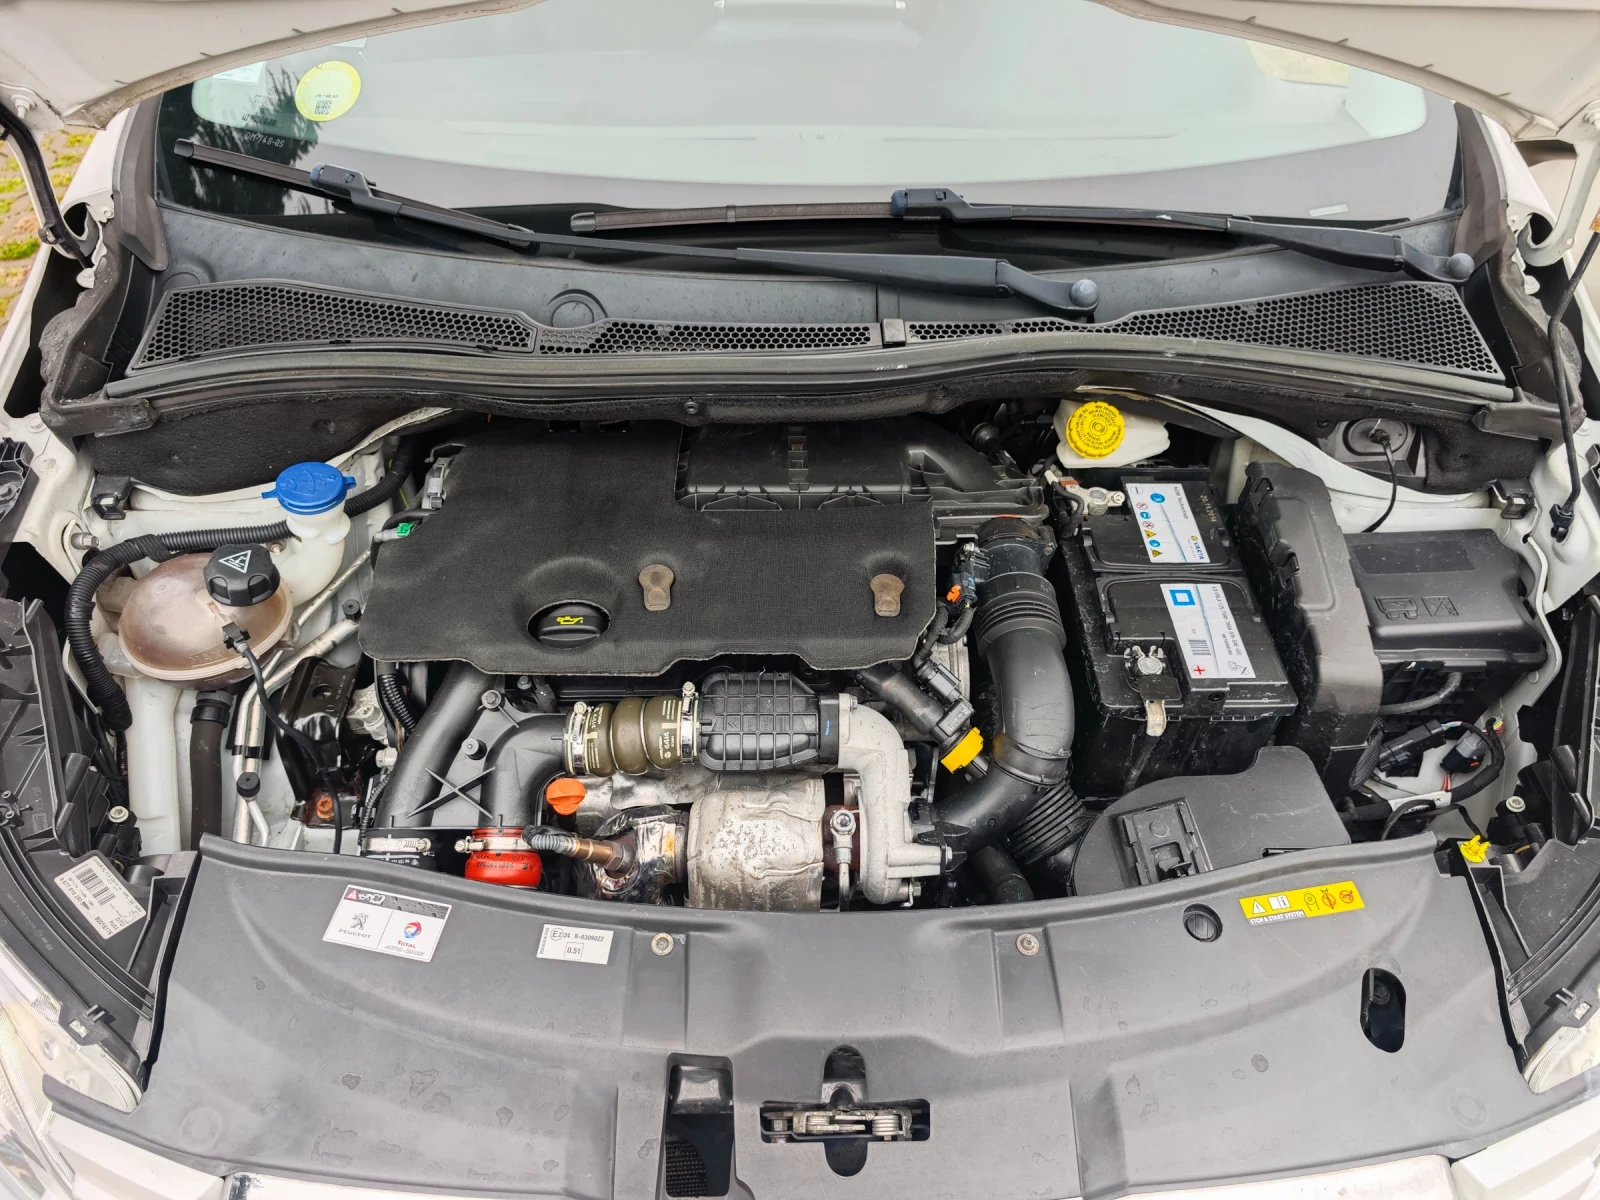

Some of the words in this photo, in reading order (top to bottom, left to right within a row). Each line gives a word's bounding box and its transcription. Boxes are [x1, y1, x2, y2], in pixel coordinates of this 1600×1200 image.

[1194, 542, 1204, 560] VARTA
[1268, 913, 1284, 921] START
[1284, 910, 1304, 919] SYSTEM
[339, 928, 372, 939] PEUGEOT
[398, 940, 416, 949] TOTAL
